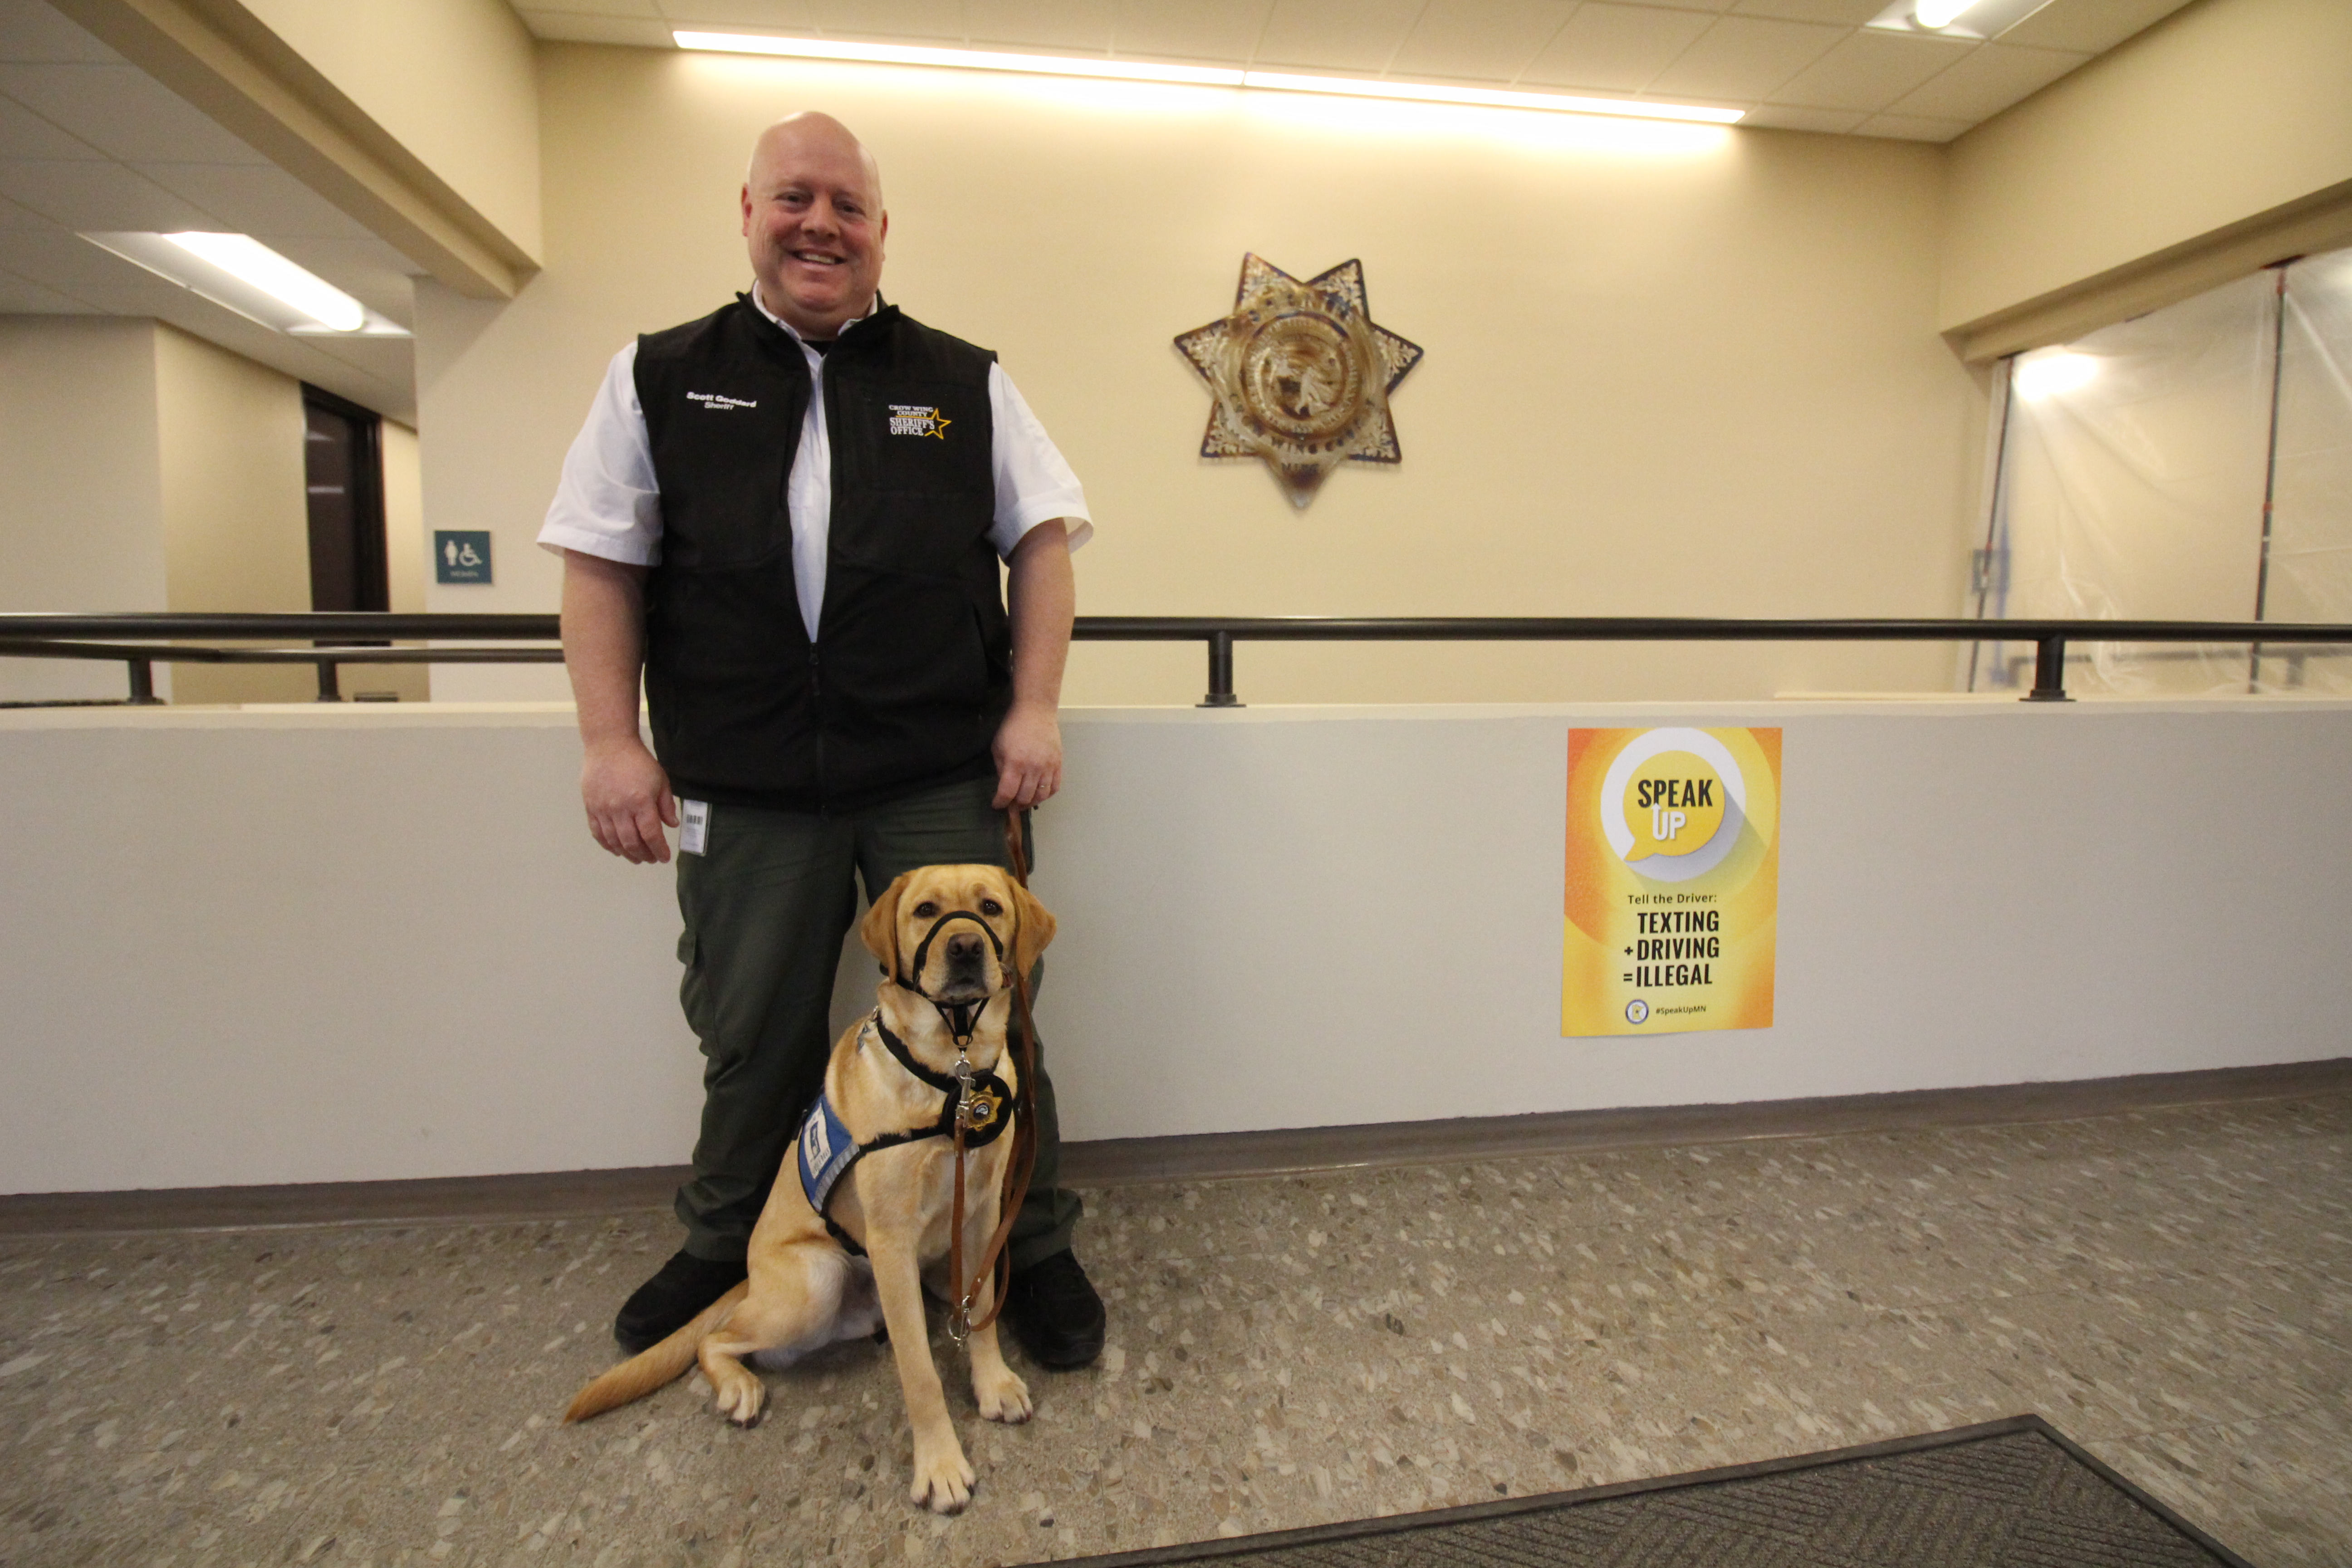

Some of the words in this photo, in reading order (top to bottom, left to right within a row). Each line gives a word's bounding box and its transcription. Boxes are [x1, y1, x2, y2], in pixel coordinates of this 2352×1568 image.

[686, 392, 715, 401] Scott
[715, 395, 757, 407] Goddard
[704, 401, 735, 410] Sheriff
[890, 417, 935, 429] SHERIFF'S
[890, 426, 924, 436] OFFICE
[1637, 779, 1713, 808] SPEAK
[1651, 802, 1686, 841] UP
[1628, 894, 1649, 904] Tell
[1653, 894, 1673, 903] the
[1677, 893, 1717, 903] Driver:
[1637, 910, 1719, 934] TEXTING
[1656, 1005, 1706, 1016] #SpeakUpMN
